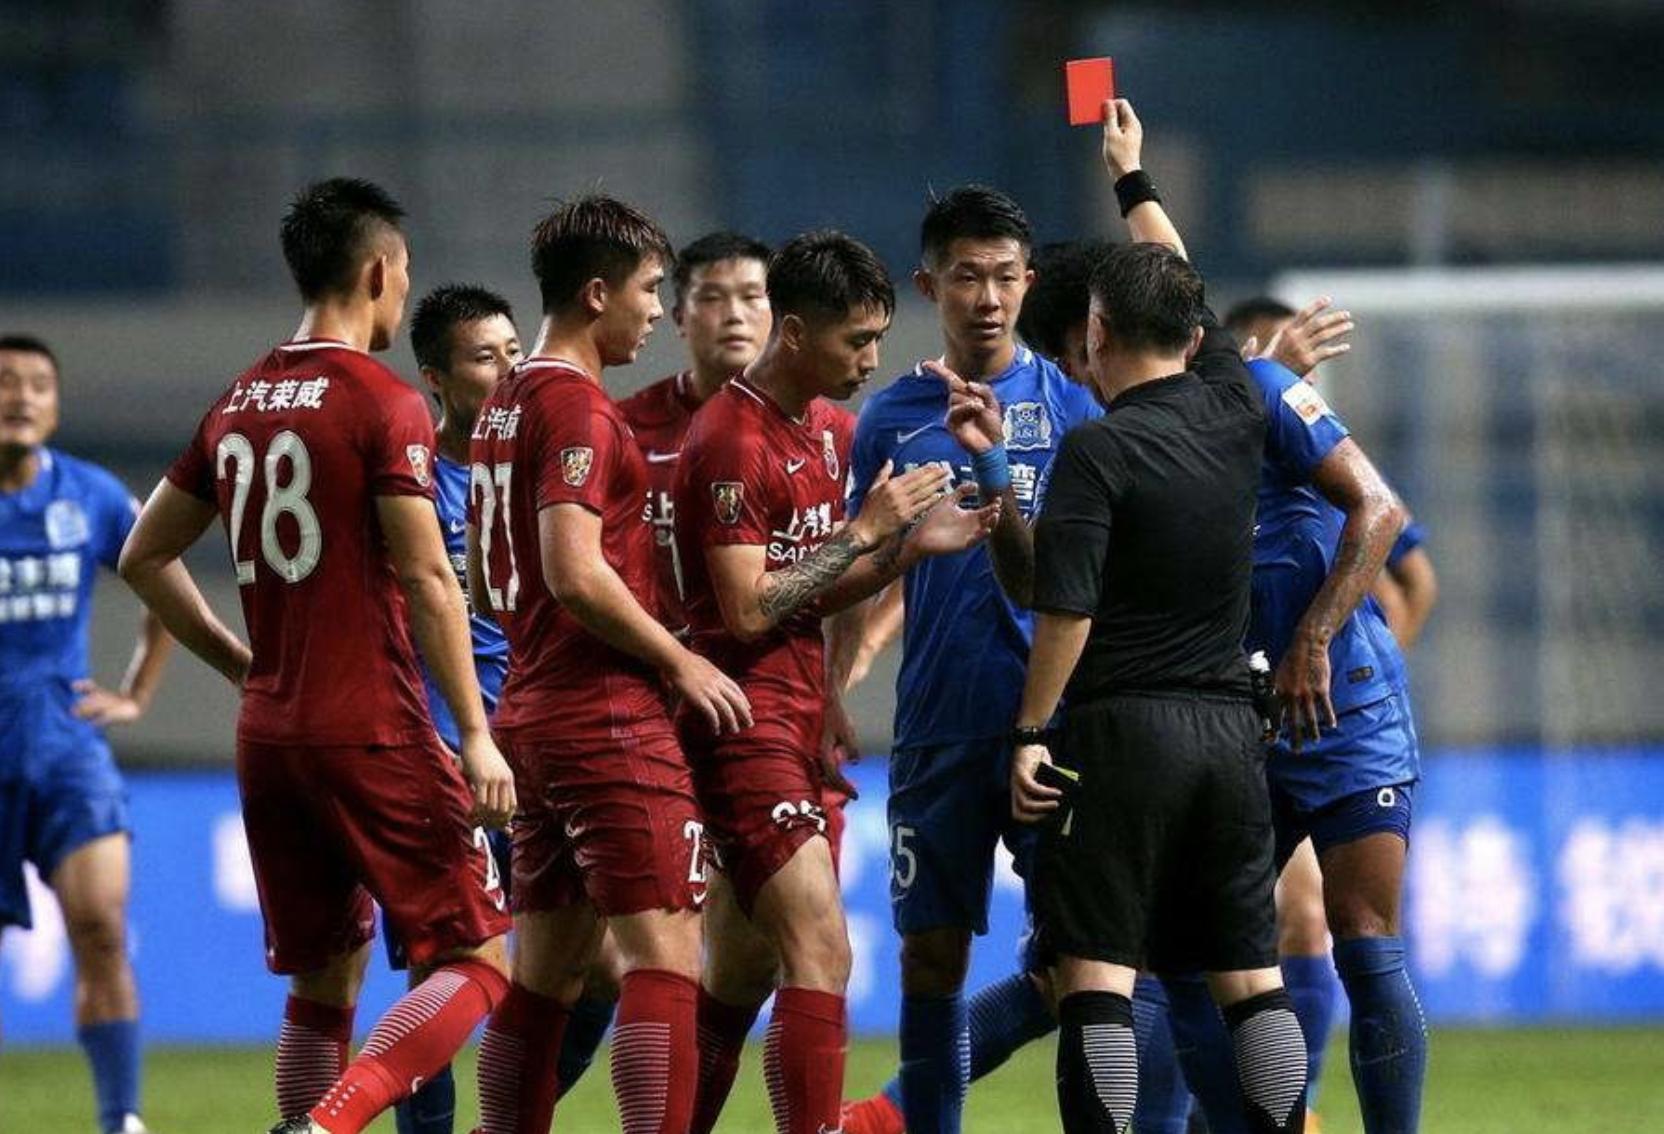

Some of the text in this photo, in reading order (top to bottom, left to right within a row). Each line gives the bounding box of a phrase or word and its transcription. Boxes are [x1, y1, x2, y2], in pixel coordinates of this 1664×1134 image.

[222, 376, 329, 414] 上汽荣威
[216, 429, 322, 584] 28
[471, 462, 520, 611] 27
